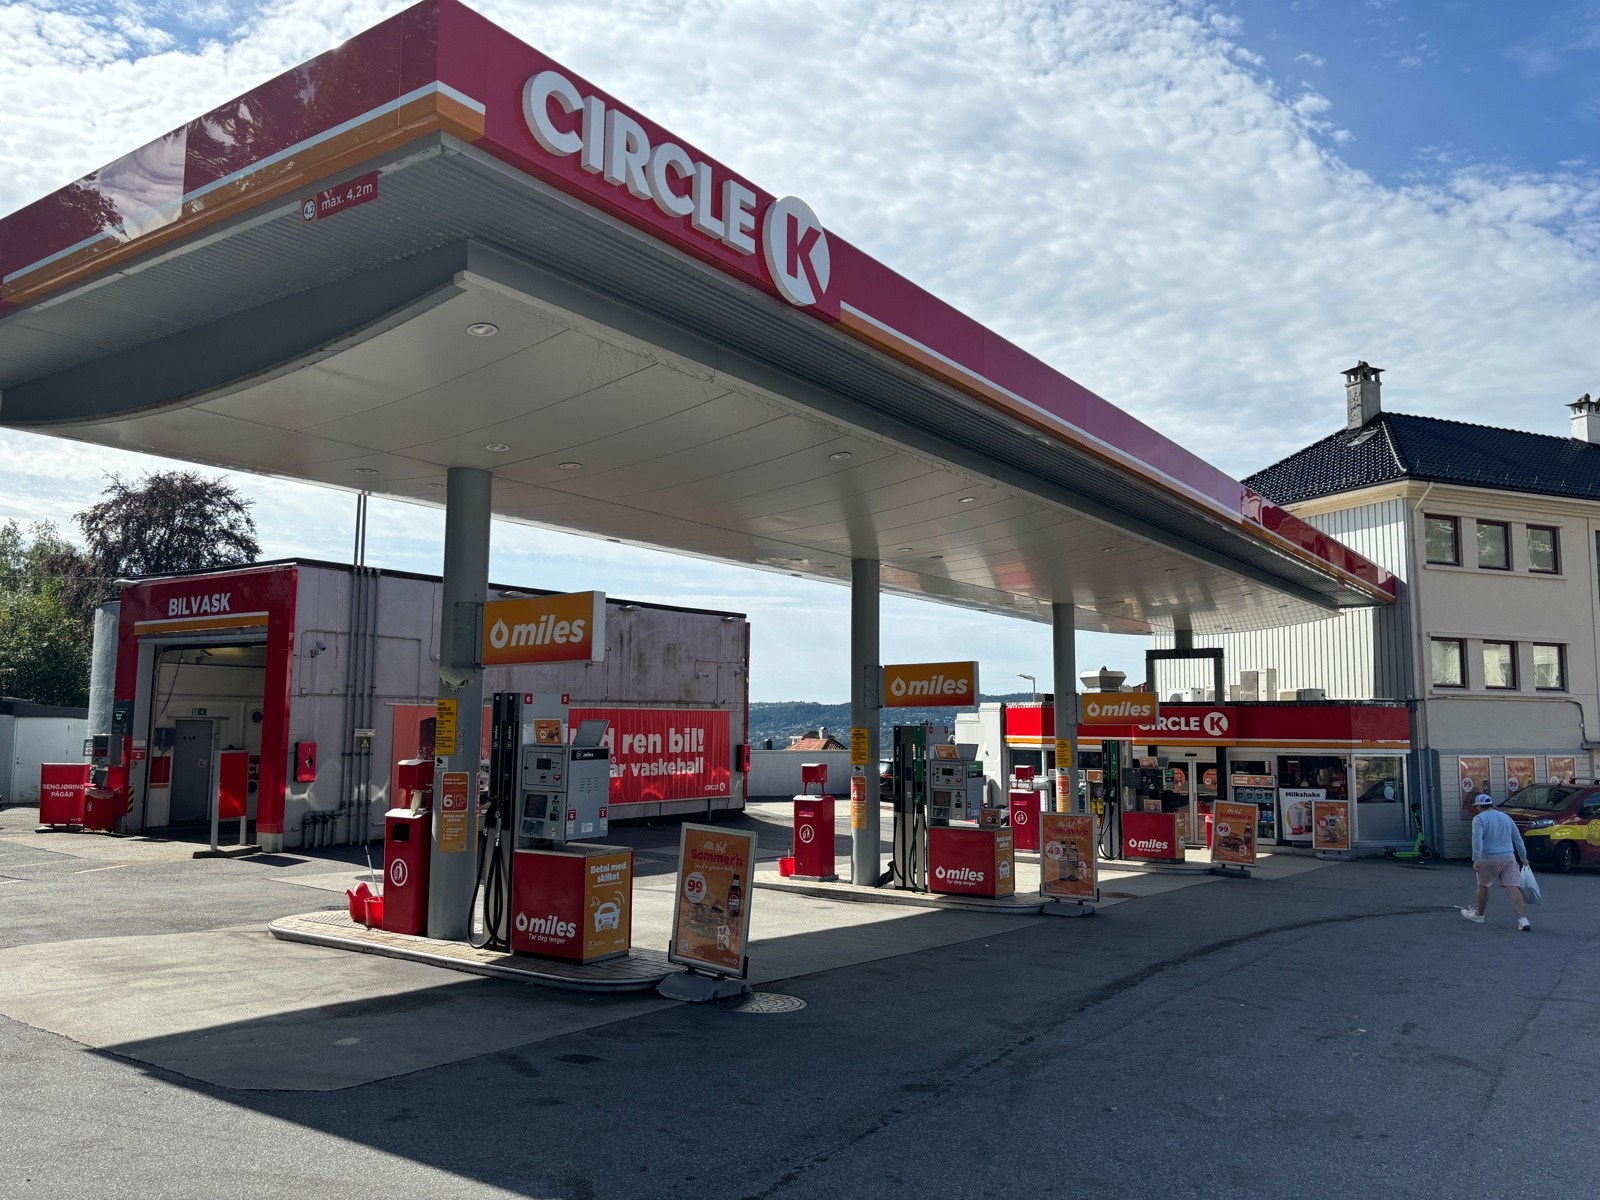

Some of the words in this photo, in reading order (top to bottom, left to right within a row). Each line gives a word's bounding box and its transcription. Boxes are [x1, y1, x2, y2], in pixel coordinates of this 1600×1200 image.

[522, 70, 757, 256] CIRCLE
[783, 208, 830, 304] K
[321, 194, 344, 211] max.
[346, 183, 373, 201] 4,2m
[168, 592, 232, 617] BILVASK
[510, 614, 586, 647] miles
[908, 674, 969, 696] miles
[1101, 701, 1151, 717] miles
[1208, 715, 1227, 735] K
[622, 732, 662, 755] ren
[668, 727, 704, 754] bil!
[609, 756, 627, 778] år
[631, 756, 704, 777] vaskehall
[50, 790, 74, 798] PÅGÅR
[443, 794, 454, 808] 6
[852, 789, 858, 799] 4
[1048, 846, 1060, 855] 49
[1137, 838, 1169, 850] miles
[690, 848, 743, 867] Sommer'n
[590, 864, 610, 874] Betal
[611, 861, 627, 871] med
[946, 867, 985, 882] miles
[597, 872, 620, 883] skiltet
[687, 878, 702, 894] 99
[528, 914, 577, 938] miles
[537, 934, 548, 943] deg
